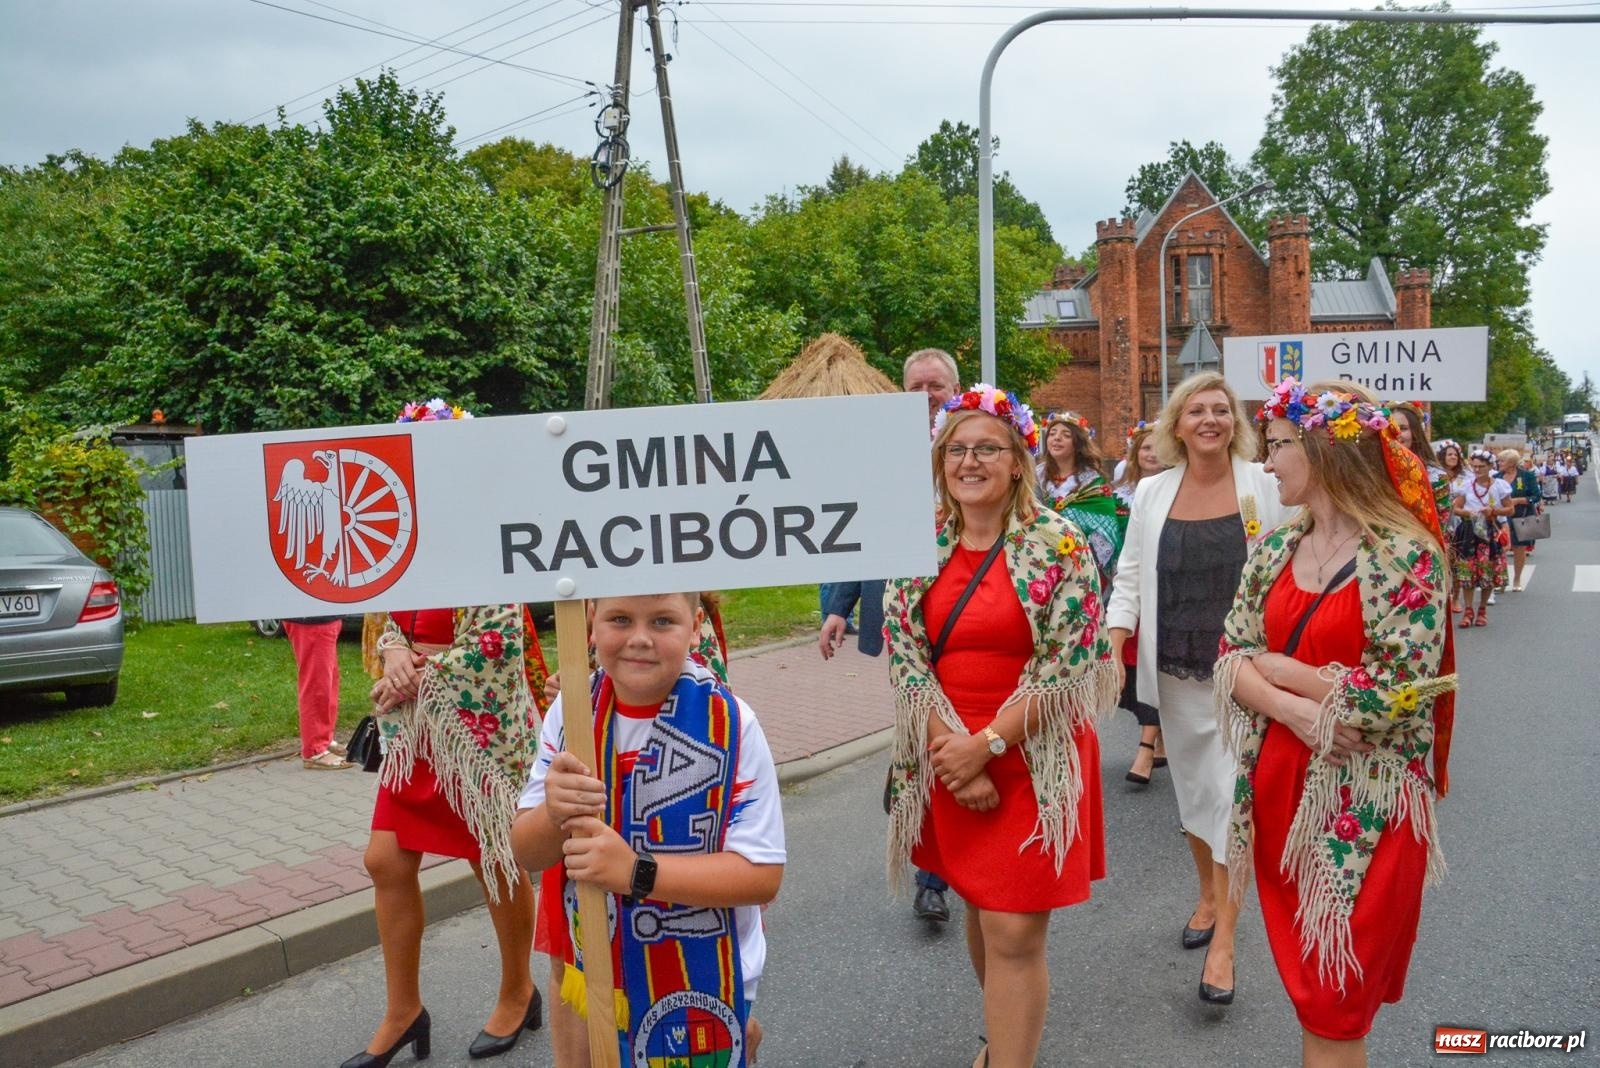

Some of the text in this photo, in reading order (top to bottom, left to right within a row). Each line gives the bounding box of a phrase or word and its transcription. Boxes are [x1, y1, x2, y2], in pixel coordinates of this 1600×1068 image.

[1331, 340, 1442, 364] GMINA
[562, 430, 791, 493] GMINA
[499, 494, 862, 574] RACIBÓRZ
[0, 595, 34, 612] V60
[642, 1010, 659, 1034] LKS
